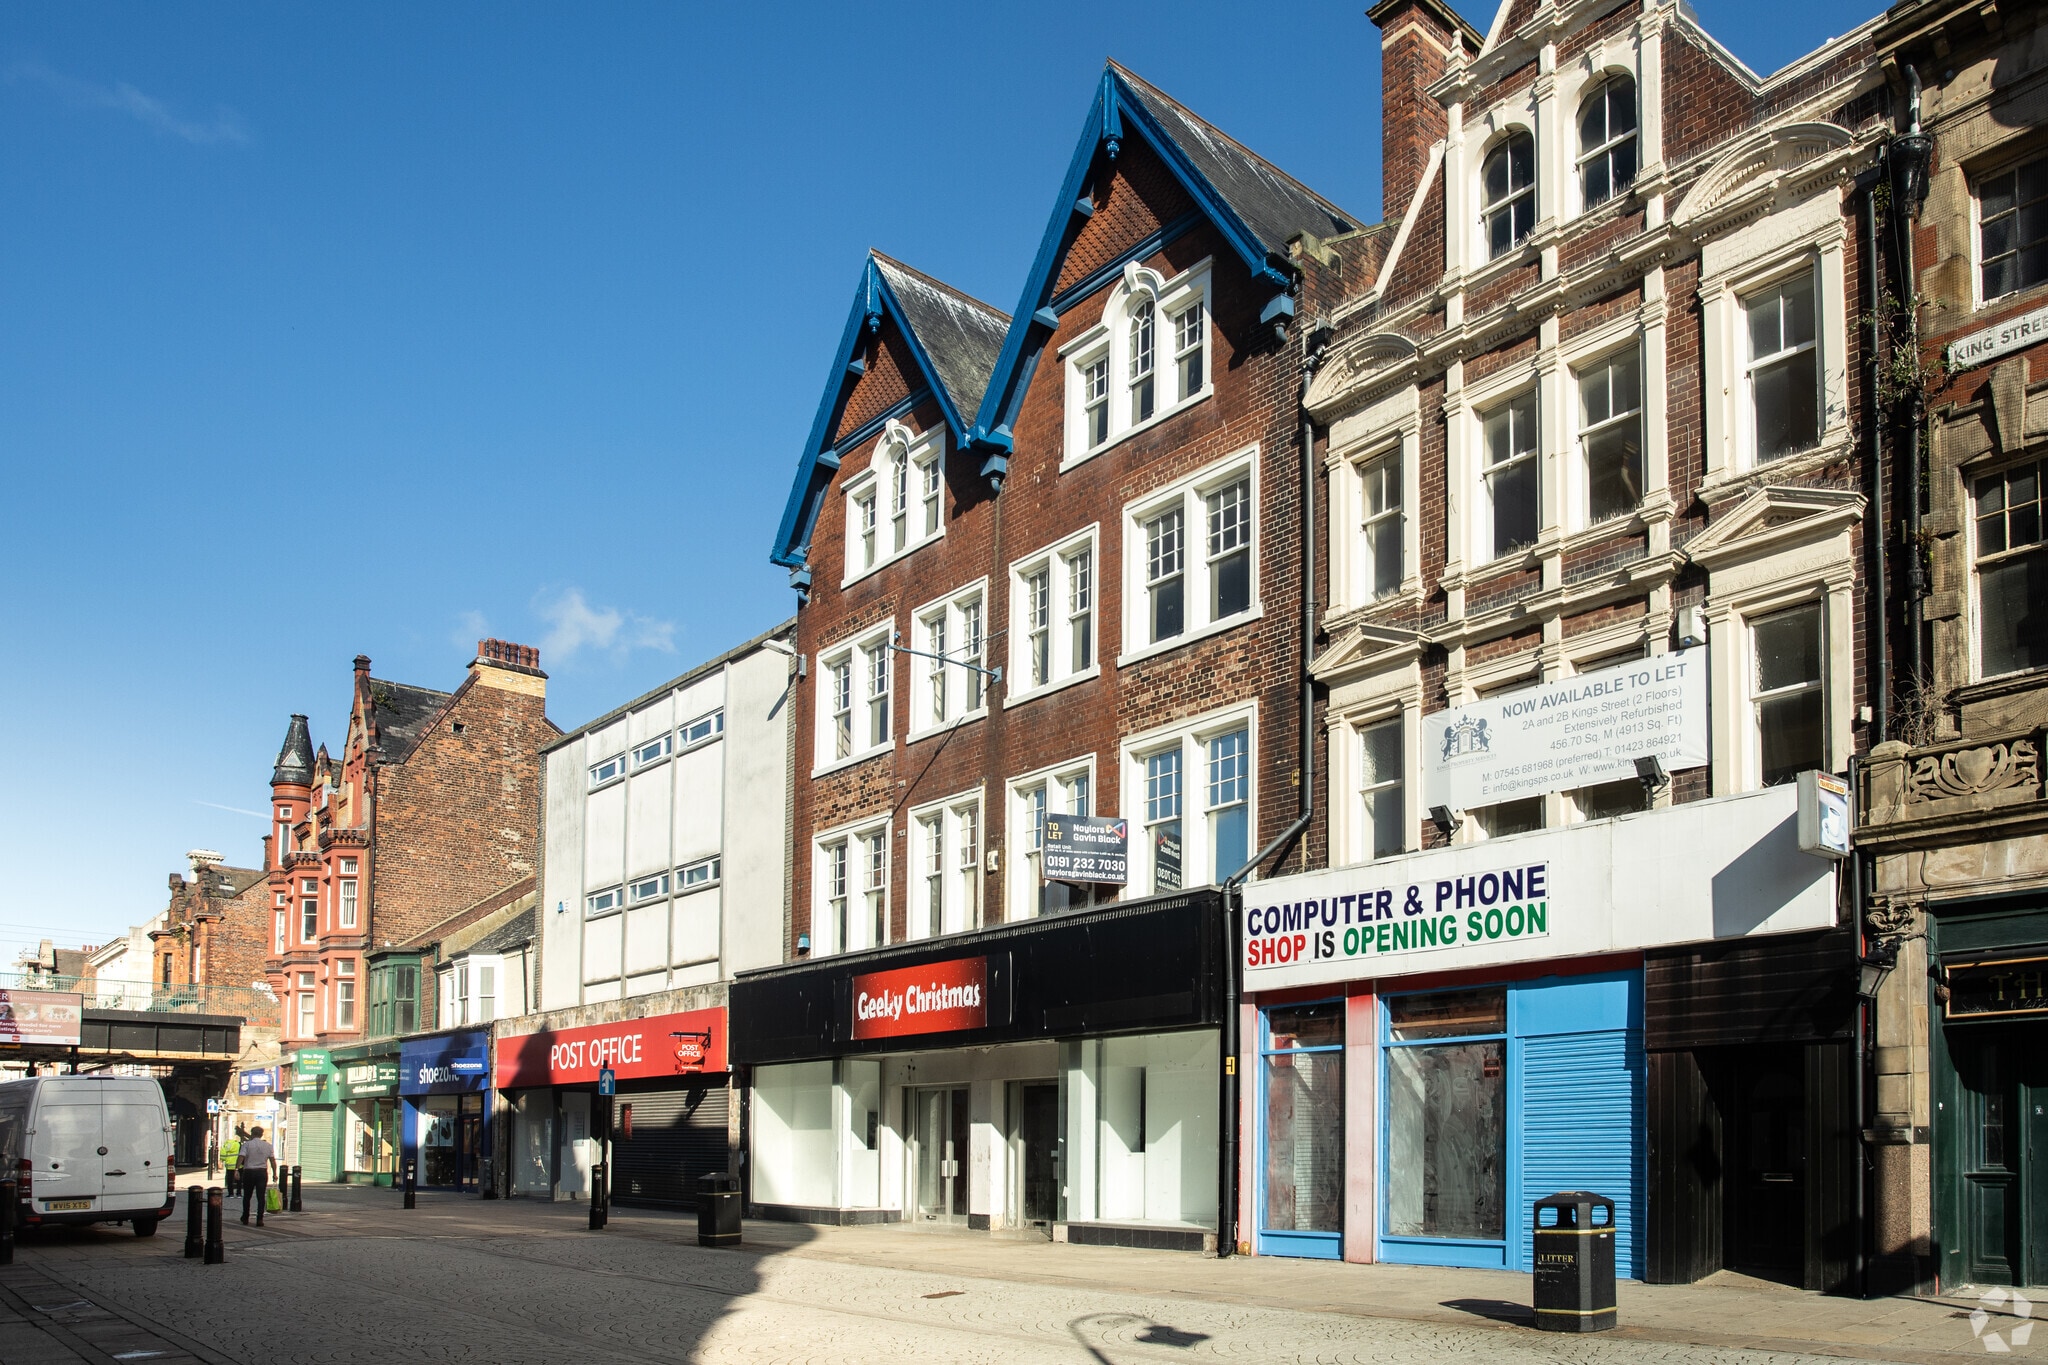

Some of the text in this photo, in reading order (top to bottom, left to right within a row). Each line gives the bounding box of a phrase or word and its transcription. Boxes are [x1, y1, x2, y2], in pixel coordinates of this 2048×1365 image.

[1954, 337, 1994, 360] KING
[1502, 662, 1687, 719] NOW AVAILABLE TO LET
[1522, 685, 1682, 731] 2A and 2B Kings Street (2 Floors)
[1564, 699, 1682, 734] Extensively Refurbished
[1550, 714, 1682, 751] 456.70 Sq. M (4913 Sq. Ft)
[1482, 733, 1682, 782] M: 07545 681968 (preferred) T: 01423 864921
[1482, 785, 1491, 795] E:
[1493, 770, 1574, 793] info@kingsps.co.uk
[1578, 765, 1590, 776] W:
[1047, 831, 1063, 840] LET
[1048, 822, 1059, 831] TO
[1073, 824, 1105, 834] Naylors
[1073, 833, 1121, 845] Gavin Black
[1047, 856, 1126, 872] 0191 232 7030
[1047, 869, 1126, 881] naylorsgavinblack.co.uk
[1250, 864, 1546, 937] COMPUTER & PHONE
[1248, 901, 1546, 967] SHOP IS OPENING SOON
[858, 982, 981, 1021] Geeky Christmas
[551, 1033, 643, 1071] POST OFFICE
[678, 1050, 701, 1058] OFFICE
[1541, 1254, 1575, 1263] LITTER
